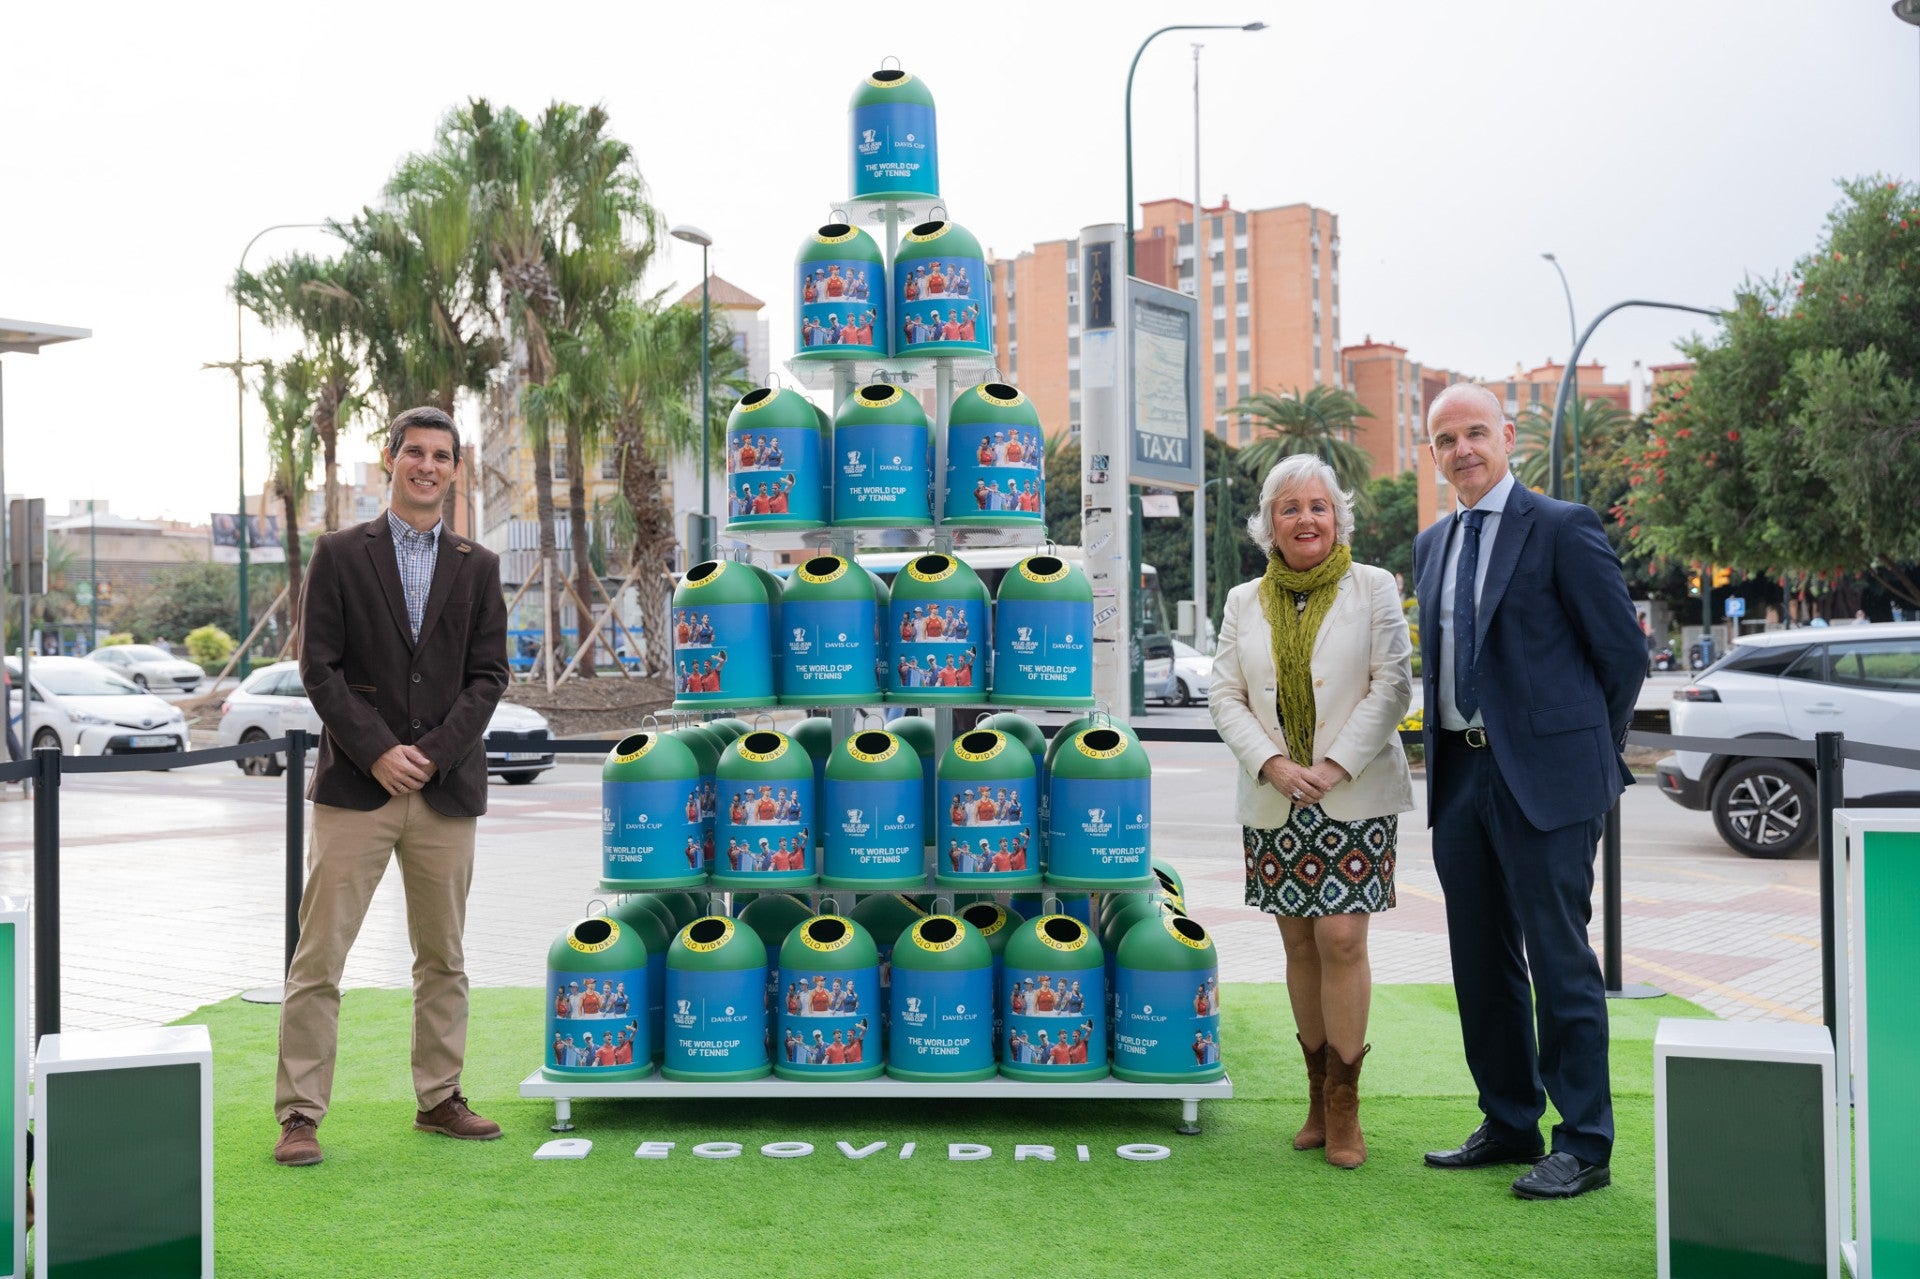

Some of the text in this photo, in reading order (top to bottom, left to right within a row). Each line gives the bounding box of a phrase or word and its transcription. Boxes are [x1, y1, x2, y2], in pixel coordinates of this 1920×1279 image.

[865, 163, 878, 171] THE
[880, 162, 904, 170] WORLD
[1091, 251, 1103, 320] TAXI
[1140, 433, 1183, 464] TAXI
[863, 486, 890, 494] WORLD
[836, 664, 852, 672] CUP
[1019, 664, 1033, 672] THE
[1034, 664, 1062, 673] WORLD
[1039, 673, 1067, 681] TENNIS
[975, 745, 1002, 760] VIDRIO
[1102, 742, 1126, 757] VIDRIO
[612, 846, 636, 854] WORLD
[637, 846, 654, 854] CUP
[866, 847, 894, 855] WORLD
[1091, 847, 1106, 855] THE
[1108, 847, 1134, 855] WORLD
[617, 854, 643, 862] TENNIS
[860, 855, 901, 864] OF TENNIS
[1102, 855, 1139, 864] OF TENNIS
[567, 935, 617, 951] SOLO VIDRIO
[683, 934, 729, 950] SOLO VIDRIO
[802, 933, 851, 950] SOLO VIDRIO
[914, 933, 962, 950] SOLO VIDRIO
[1040, 932, 1088, 950] SOLO VIDRIO
[1131, 1013, 1150, 1021] DAVIS
[679, 1039, 692, 1047] THE
[693, 1040, 722, 1048] WORLD
[908, 1037, 970, 1046] THE WORLD CUP
[1120, 1035, 1141, 1046] WORLD
[1142, 1039, 1158, 1047] CUP
[688, 1048, 729, 1056] OF TENNIS
[929, 1046, 960, 1055] TENNIS
[1124, 1044, 1147, 1055] TENNIS
[634, 1141, 1171, 1161] ECOVIDRIO
